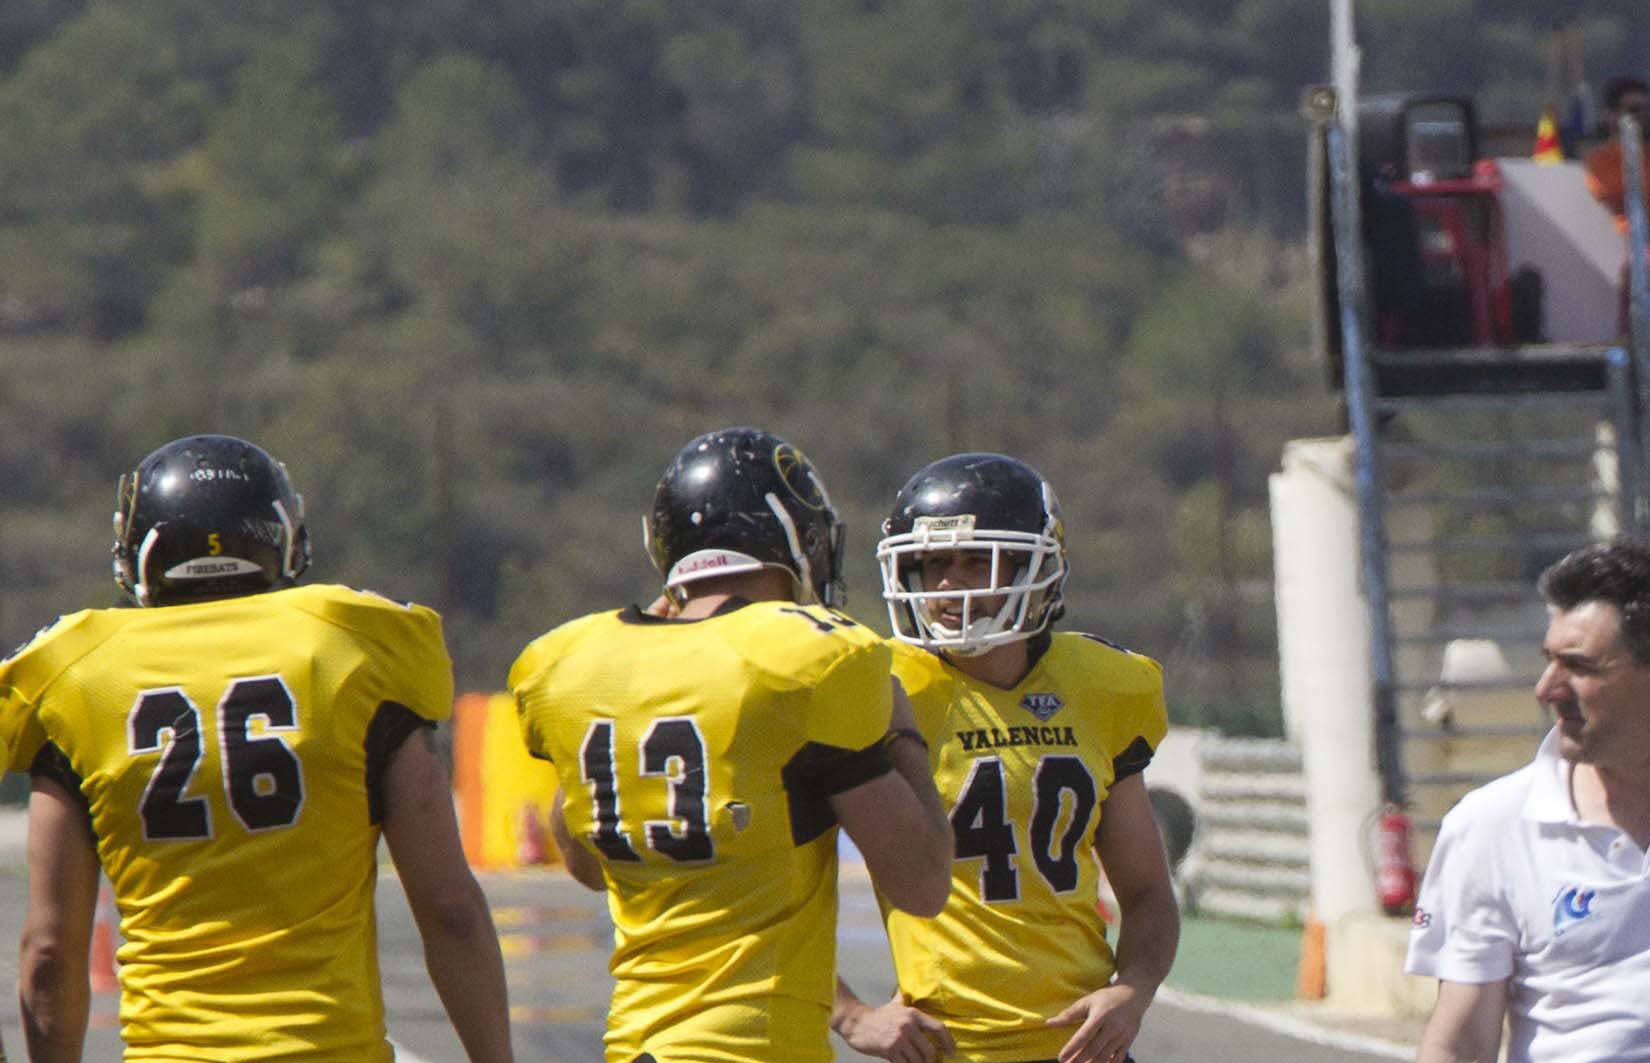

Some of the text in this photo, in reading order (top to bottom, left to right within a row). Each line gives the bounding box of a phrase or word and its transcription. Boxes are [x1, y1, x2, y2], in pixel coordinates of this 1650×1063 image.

[207, 533, 222, 556] 5
[126, 672, 307, 842] 26
[578, 714, 717, 863] 13
[956, 726, 1079, 751] VALENCIA
[947, 754, 1098, 904] 40
